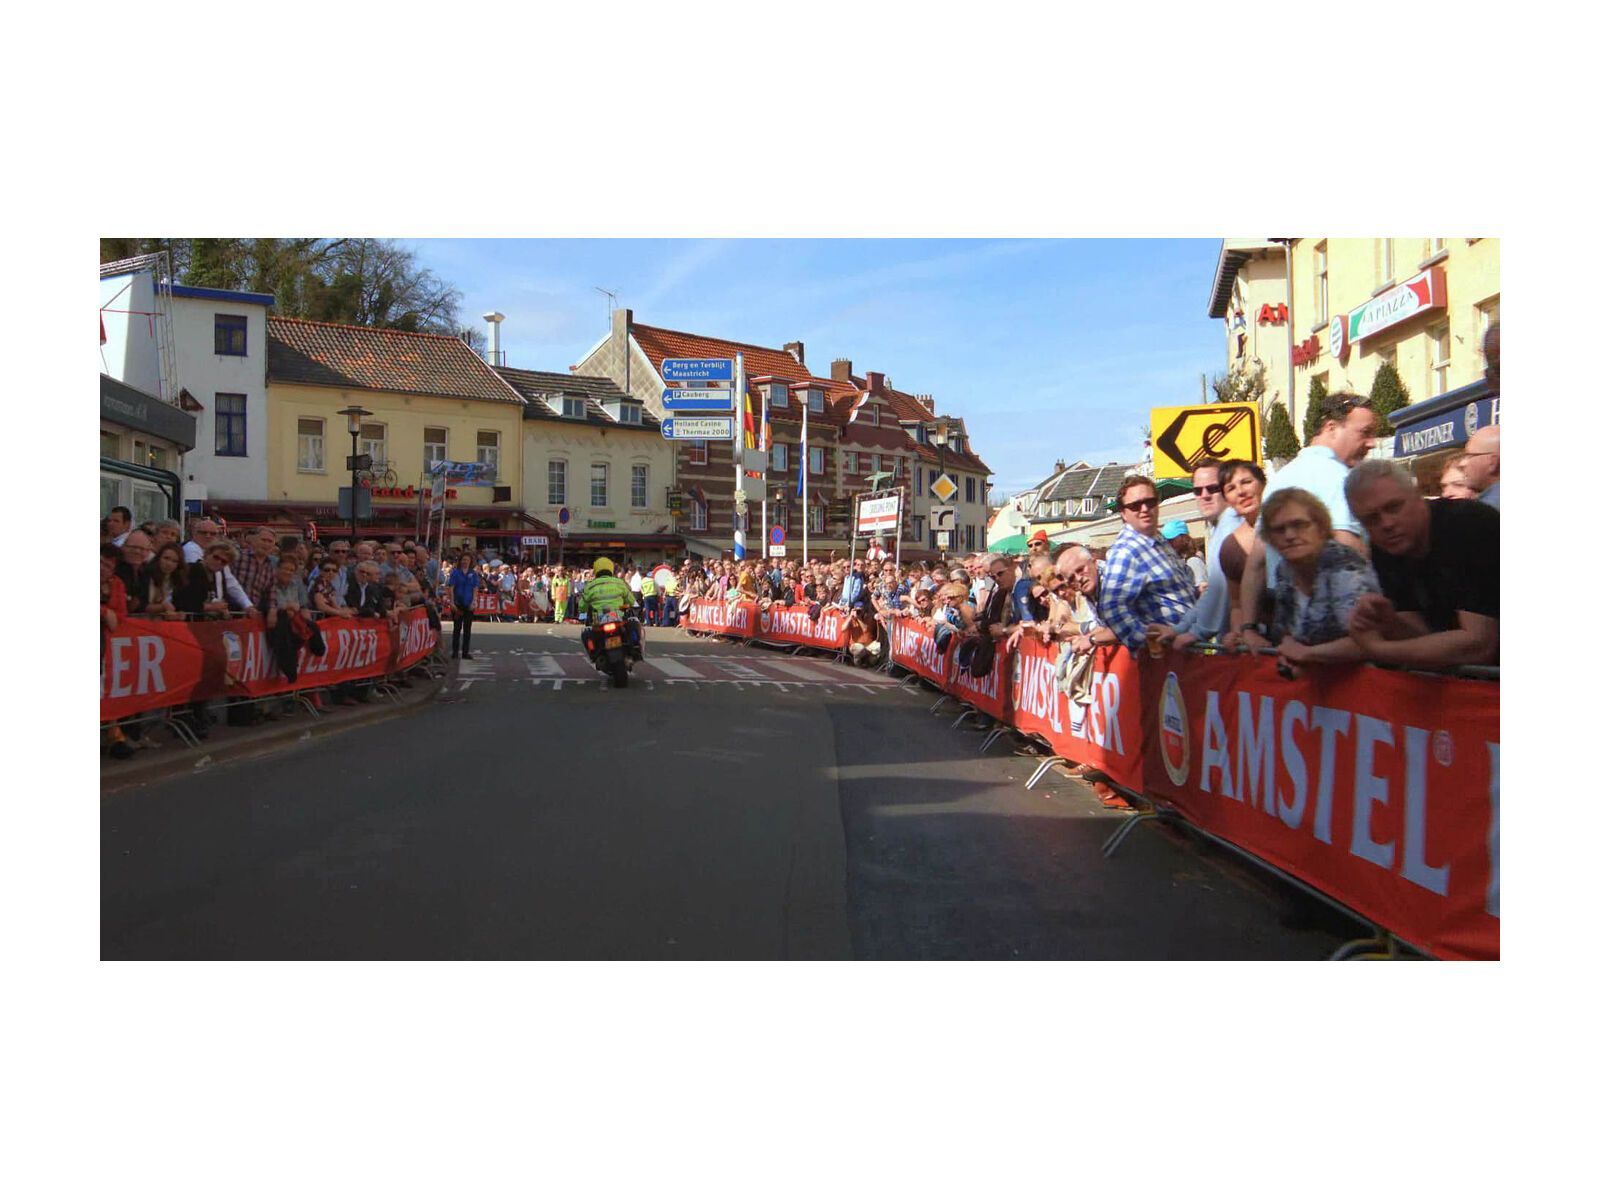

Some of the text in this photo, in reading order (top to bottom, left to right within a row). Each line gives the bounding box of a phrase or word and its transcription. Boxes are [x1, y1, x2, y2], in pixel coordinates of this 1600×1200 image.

[1361, 291, 1414, 324] LA PIAZZA
[673, 362, 688, 370] Berg
[701, 362, 725, 370] Terblijt
[1401, 421, 1454, 454] WARSTEINER
[771, 611, 812, 638] AMSTEL
[100, 635, 166, 699] ER
[242, 629, 378, 682] AMEL BIER
[1068, 671, 1125, 756] ER
[1200, 690, 1449, 898] AMSTEL
